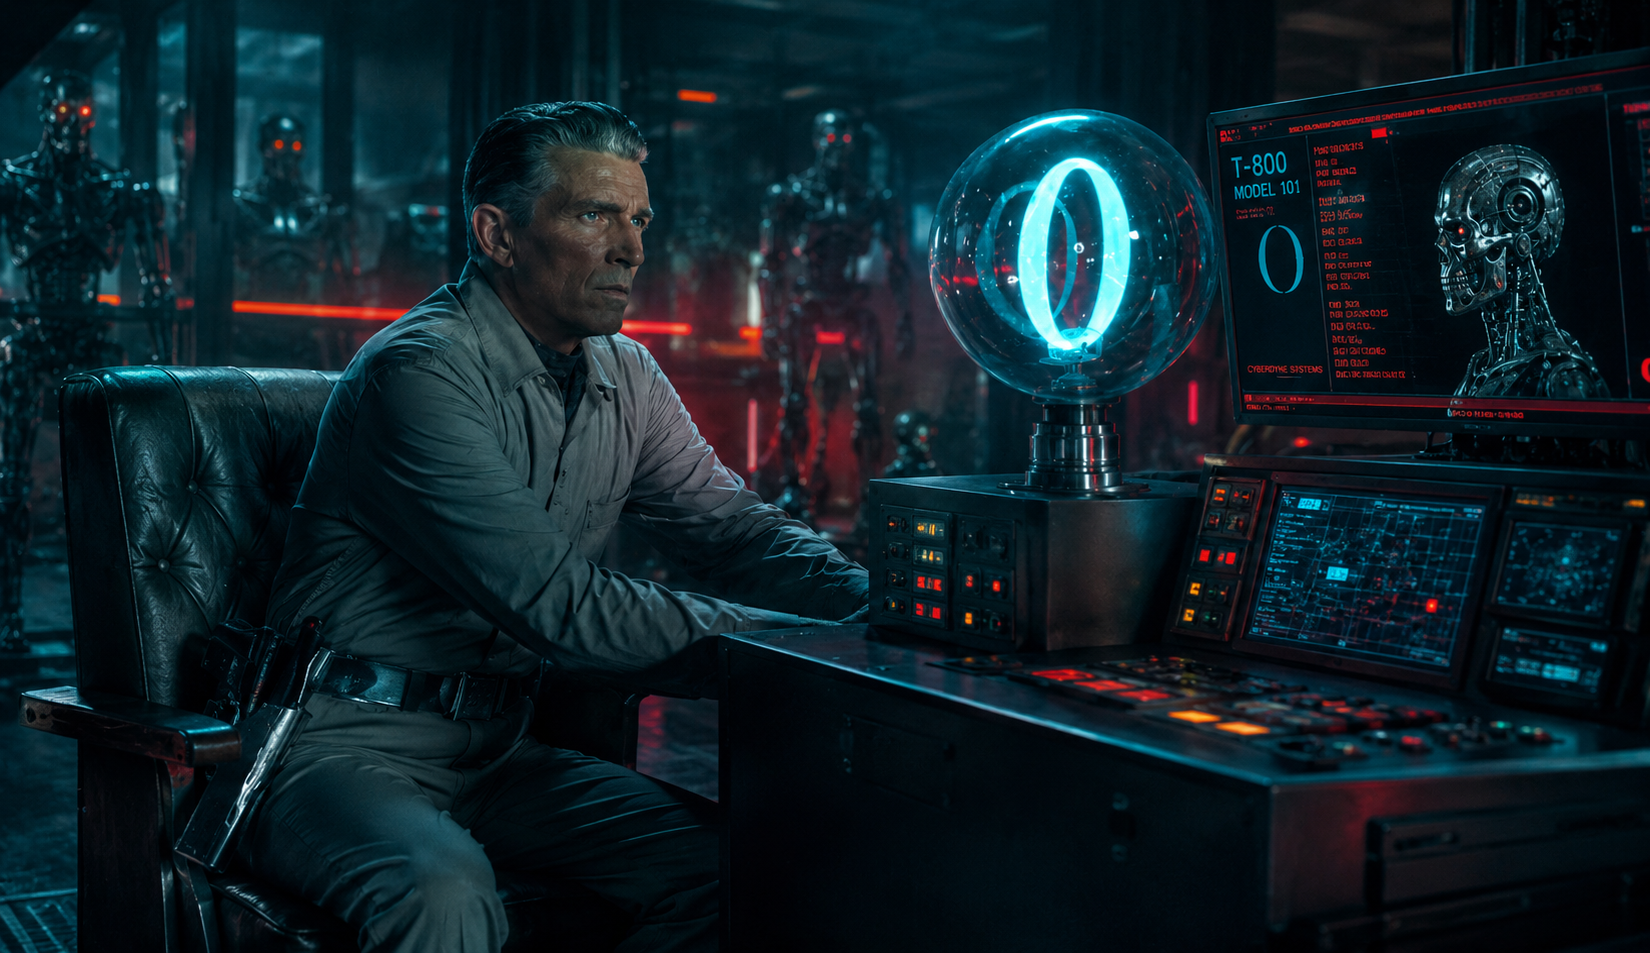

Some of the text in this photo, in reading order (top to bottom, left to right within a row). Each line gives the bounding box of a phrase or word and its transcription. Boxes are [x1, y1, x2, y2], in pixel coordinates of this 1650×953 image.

[1231, 151, 1287, 178] T-800
[1234, 182, 1276, 200] MODEL
[1280, 179, 1300, 195] 101
